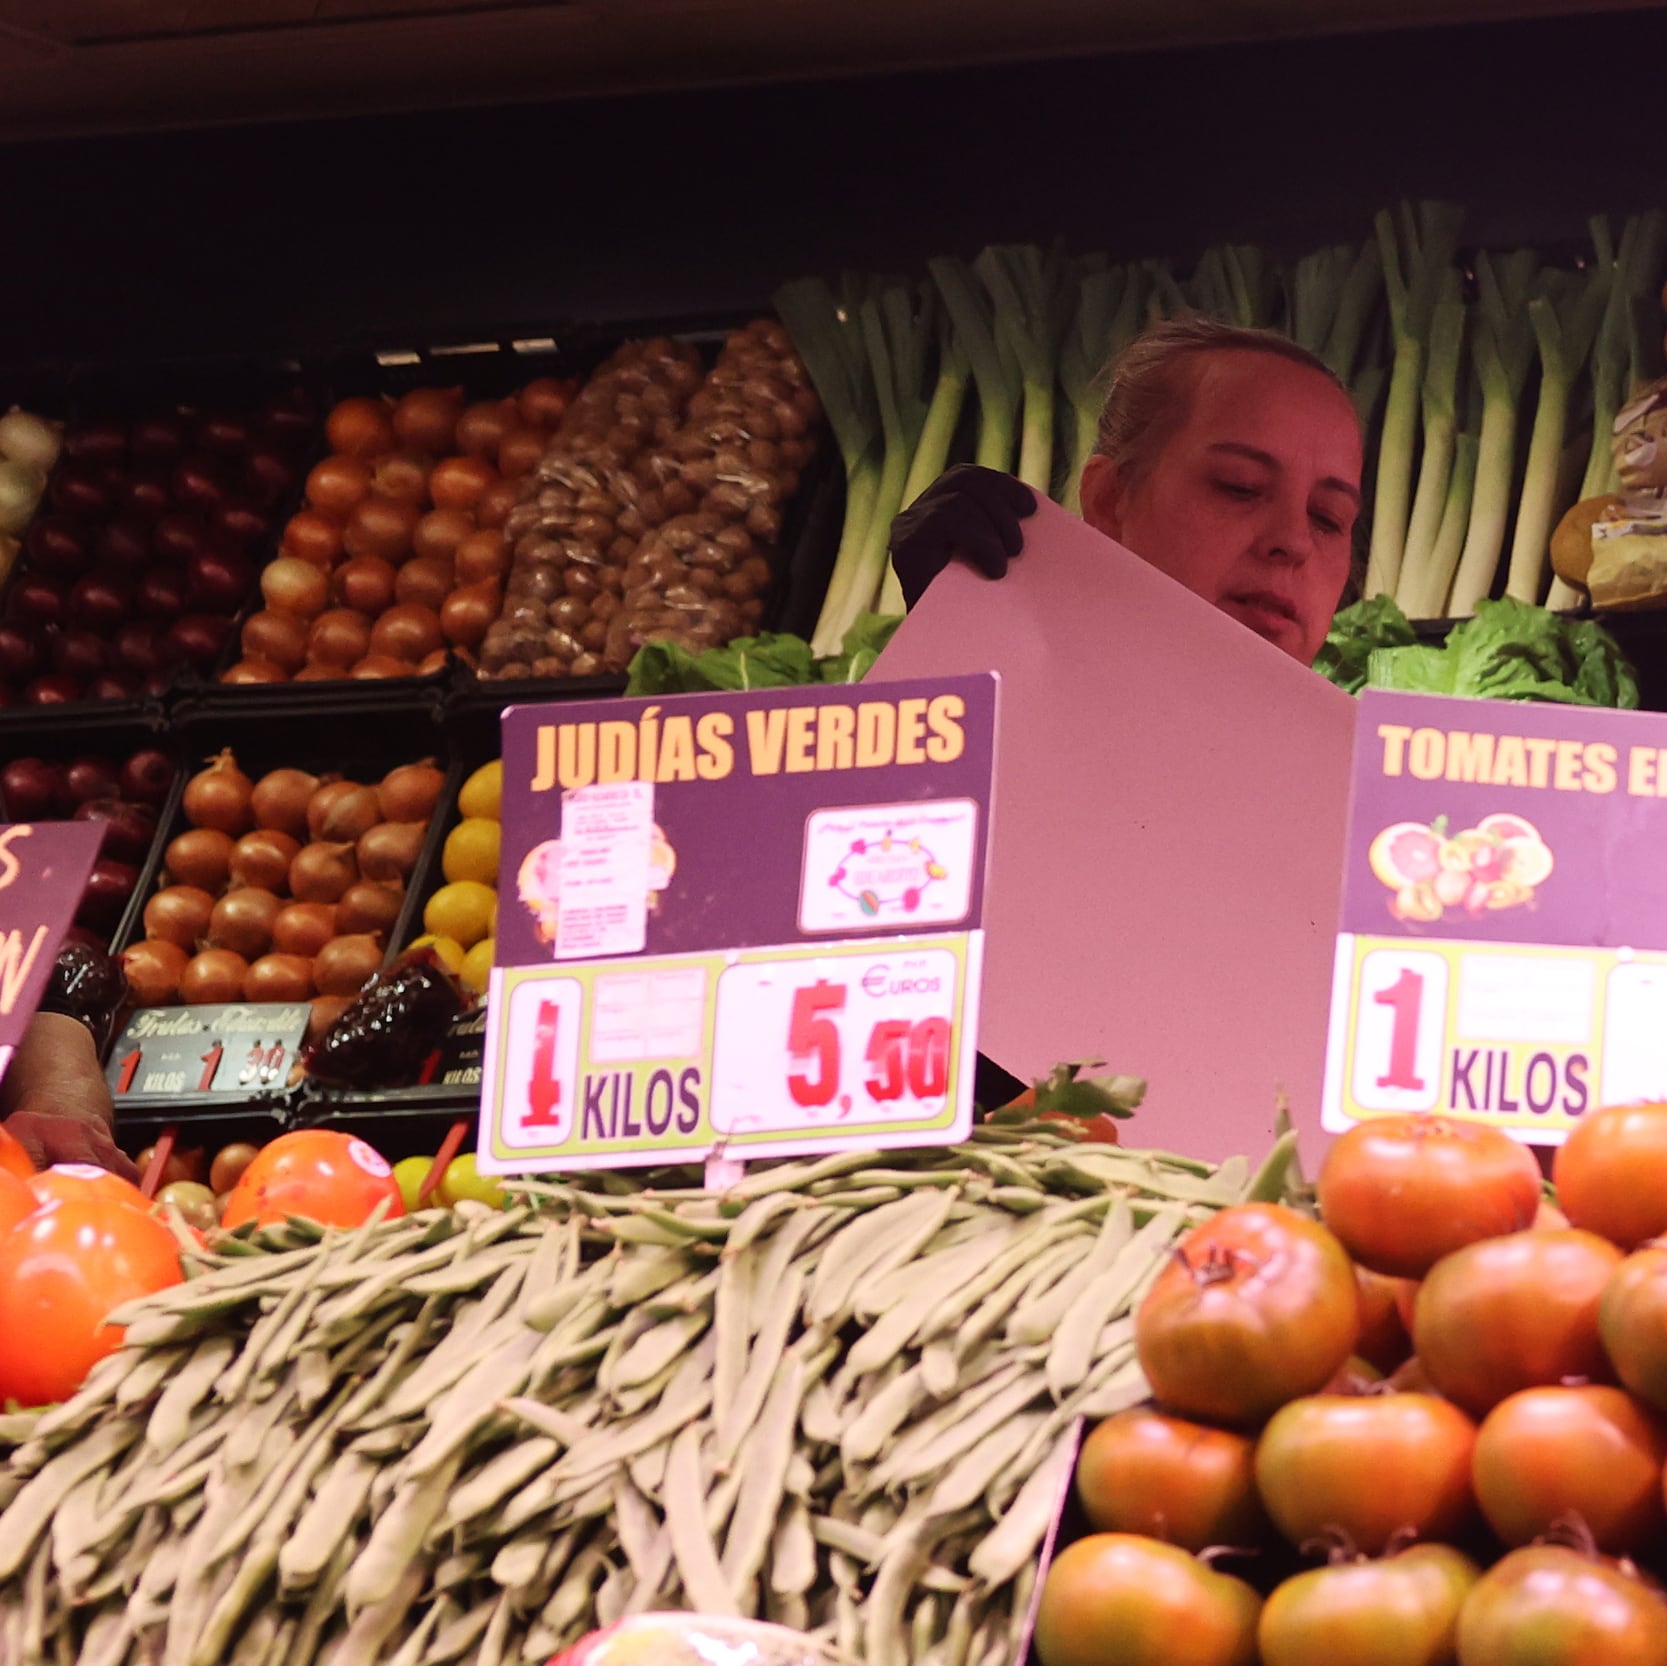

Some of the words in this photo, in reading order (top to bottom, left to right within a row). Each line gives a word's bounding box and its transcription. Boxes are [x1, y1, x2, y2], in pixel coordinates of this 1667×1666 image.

[531, 706, 736, 792] JUDÍAS
[746, 694, 967, 777] VERDES
[1377, 724, 1618, 795] TOMATES
[1374, 968, 1426, 1091] 1
[580, 1067, 701, 1141] KILOS
[1450, 1048, 1590, 1116] KILOS
